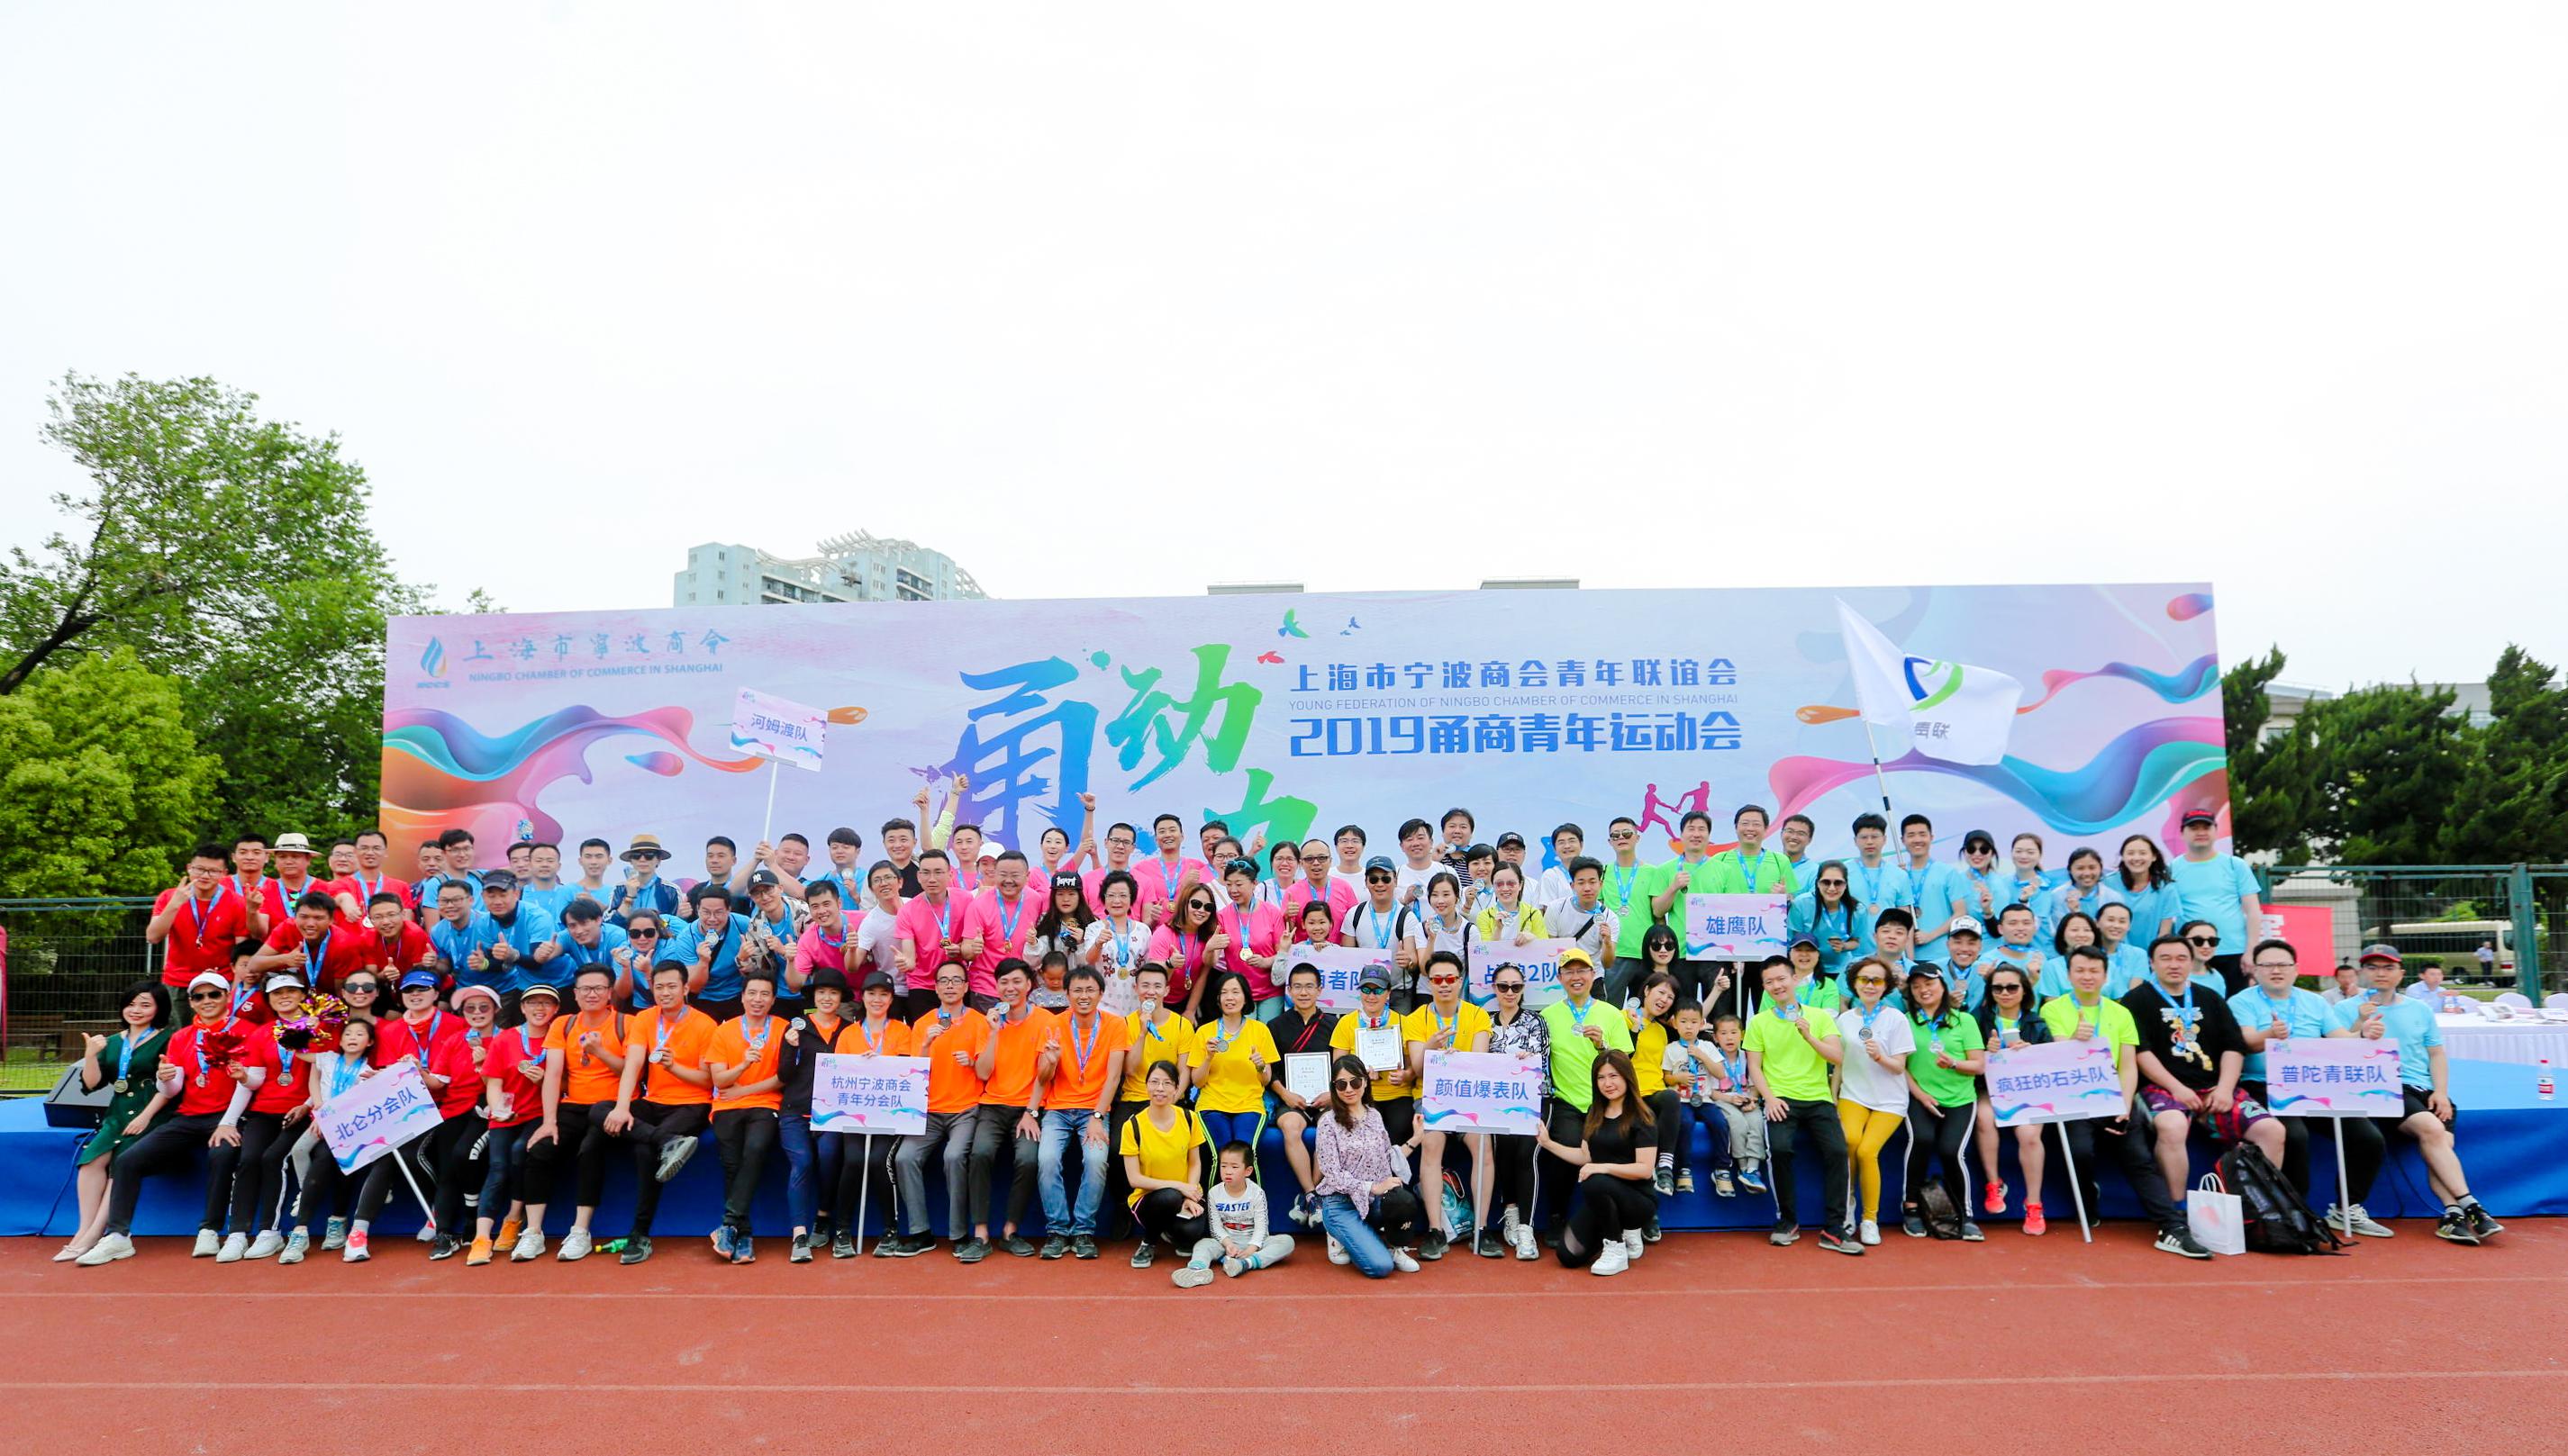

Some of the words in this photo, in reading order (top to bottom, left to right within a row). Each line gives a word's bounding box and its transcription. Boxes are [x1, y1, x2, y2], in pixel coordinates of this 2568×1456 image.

[468, 672, 513, 683] NINGBO
[514, 669, 567, 681] CHAMBER
[568, 668, 585, 678] OF
[586, 665, 646, 677] COMMERCE
[649, 665, 661, 674] IN
[665, 663, 723, 674] SHANGHAI
[1290, 658, 1738, 692] 上海市宁波商会青年联谊会
[1289, 700, 1333, 711] YOUNG
[1336, 698, 1416, 710] FEDERATION
[1420, 697, 1436, 708] OF
[1440, 696, 1490, 708] NINGBO
[1493, 695, 1556, 707] CHAMBER
[1560, 694, 1577, 706] OF
[1580, 694, 1652, 706] COMMERCE
[1656, 693, 1670, 705] IN
[1673, 693, 1738, 705] SHANGHAI
[750, 713, 808, 743] 河姆渡队
[1290, 711, 1743, 757] 2019甬商青年运动会
[1706, 915, 1767, 936] 雄鹰队
[831, 1075, 912, 1092] 杭州宁波商会
[1995, 1065, 2109, 1093] 疯狂的石头队
[2281, 1064, 2387, 1084] 普陀青联队
[1435, 1078, 1529, 1100] 颜值爆表队
[837, 1092, 903, 1108] 青年分会队
[335, 1087, 418, 1141] 北仑分会队
